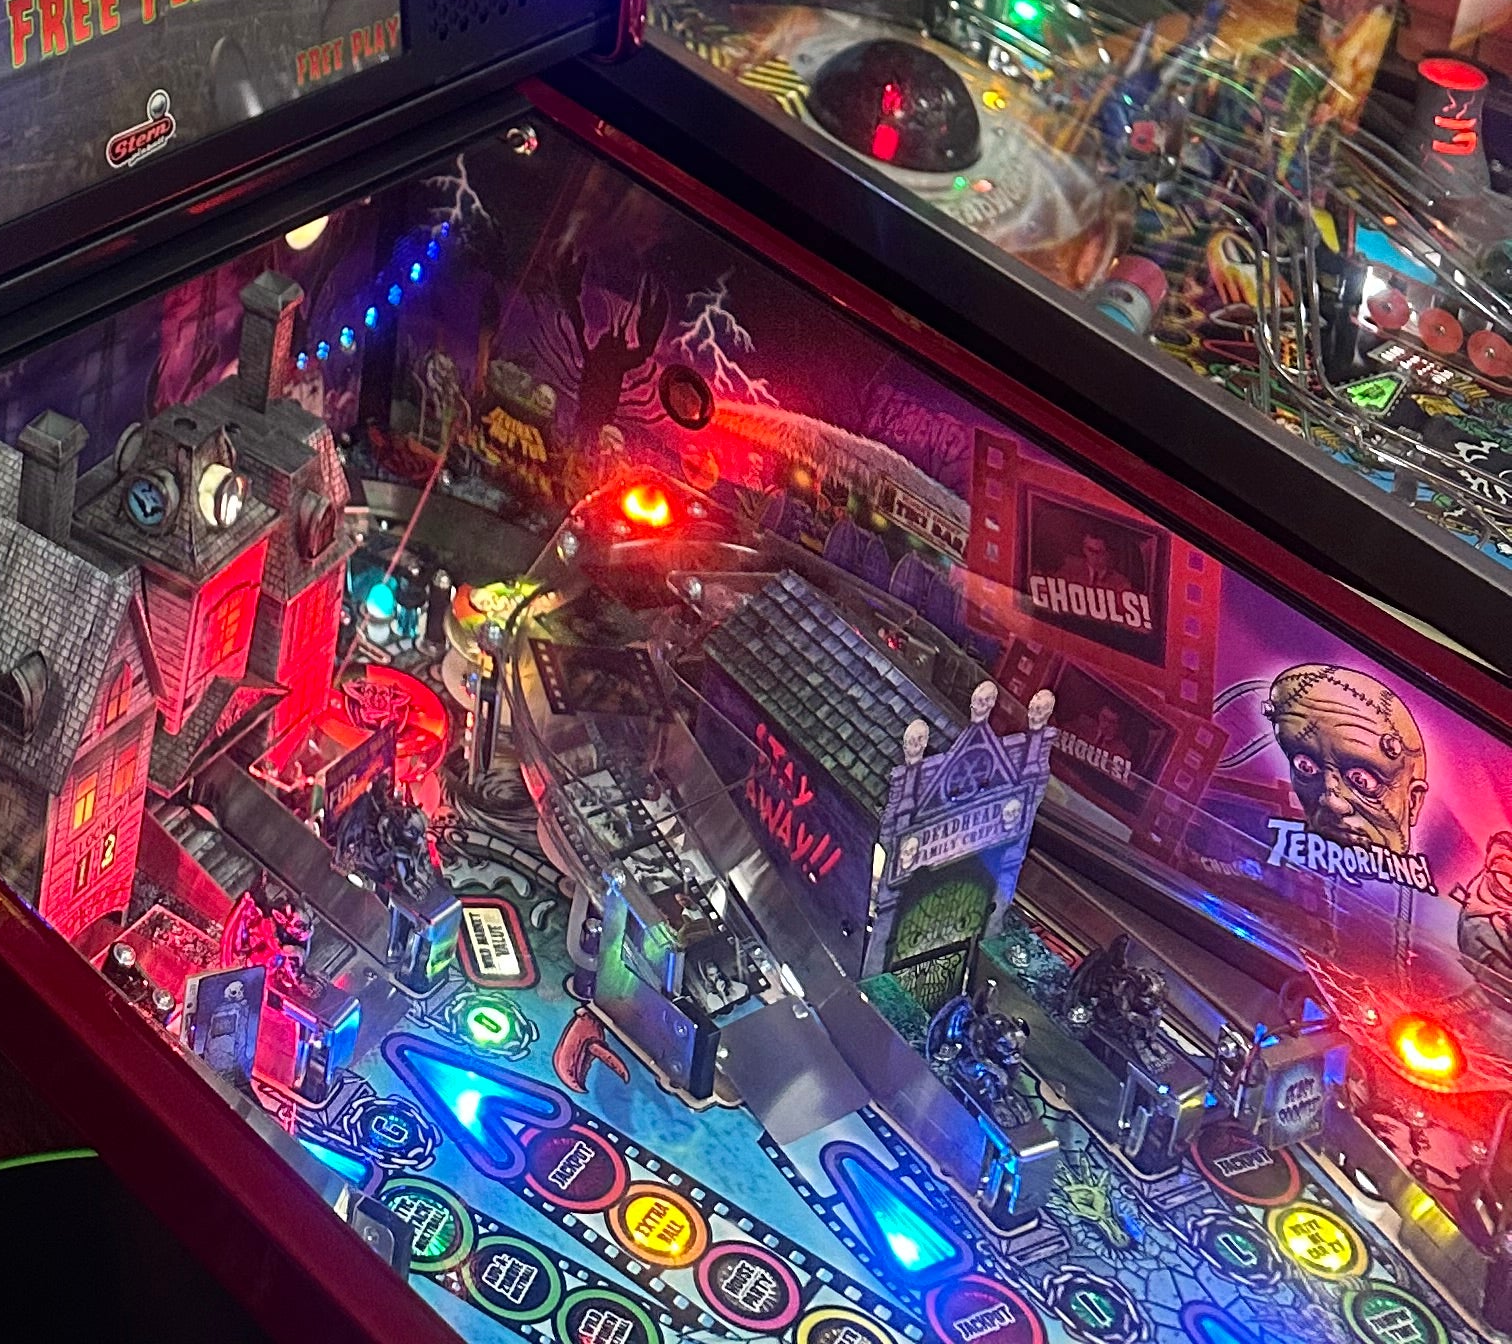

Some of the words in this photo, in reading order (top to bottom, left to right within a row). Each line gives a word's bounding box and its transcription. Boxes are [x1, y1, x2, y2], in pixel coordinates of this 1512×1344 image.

[295, 32, 346, 86] FREE
[351, 14, 400, 69] PLAY
[114, 122, 167, 157] Stern
[1028, 575, 1153, 631] GHOULS!
[922, 803, 1003, 845] DEADHEAD
[100, 832, 117, 869] 2
[487, 923, 510, 957] VALUE
[549, 1141, 596, 1190] JACKPOT
[1213, 1146, 1273, 1177] JACKPOT
[633, 1201, 670, 1240] EXTRA
[659, 1220, 686, 1248] BALL
[722, 1261, 755, 1297] HOUSE
[740, 1267, 775, 1313] PARTY
[951, 1302, 1014, 1342] JACKPOT
